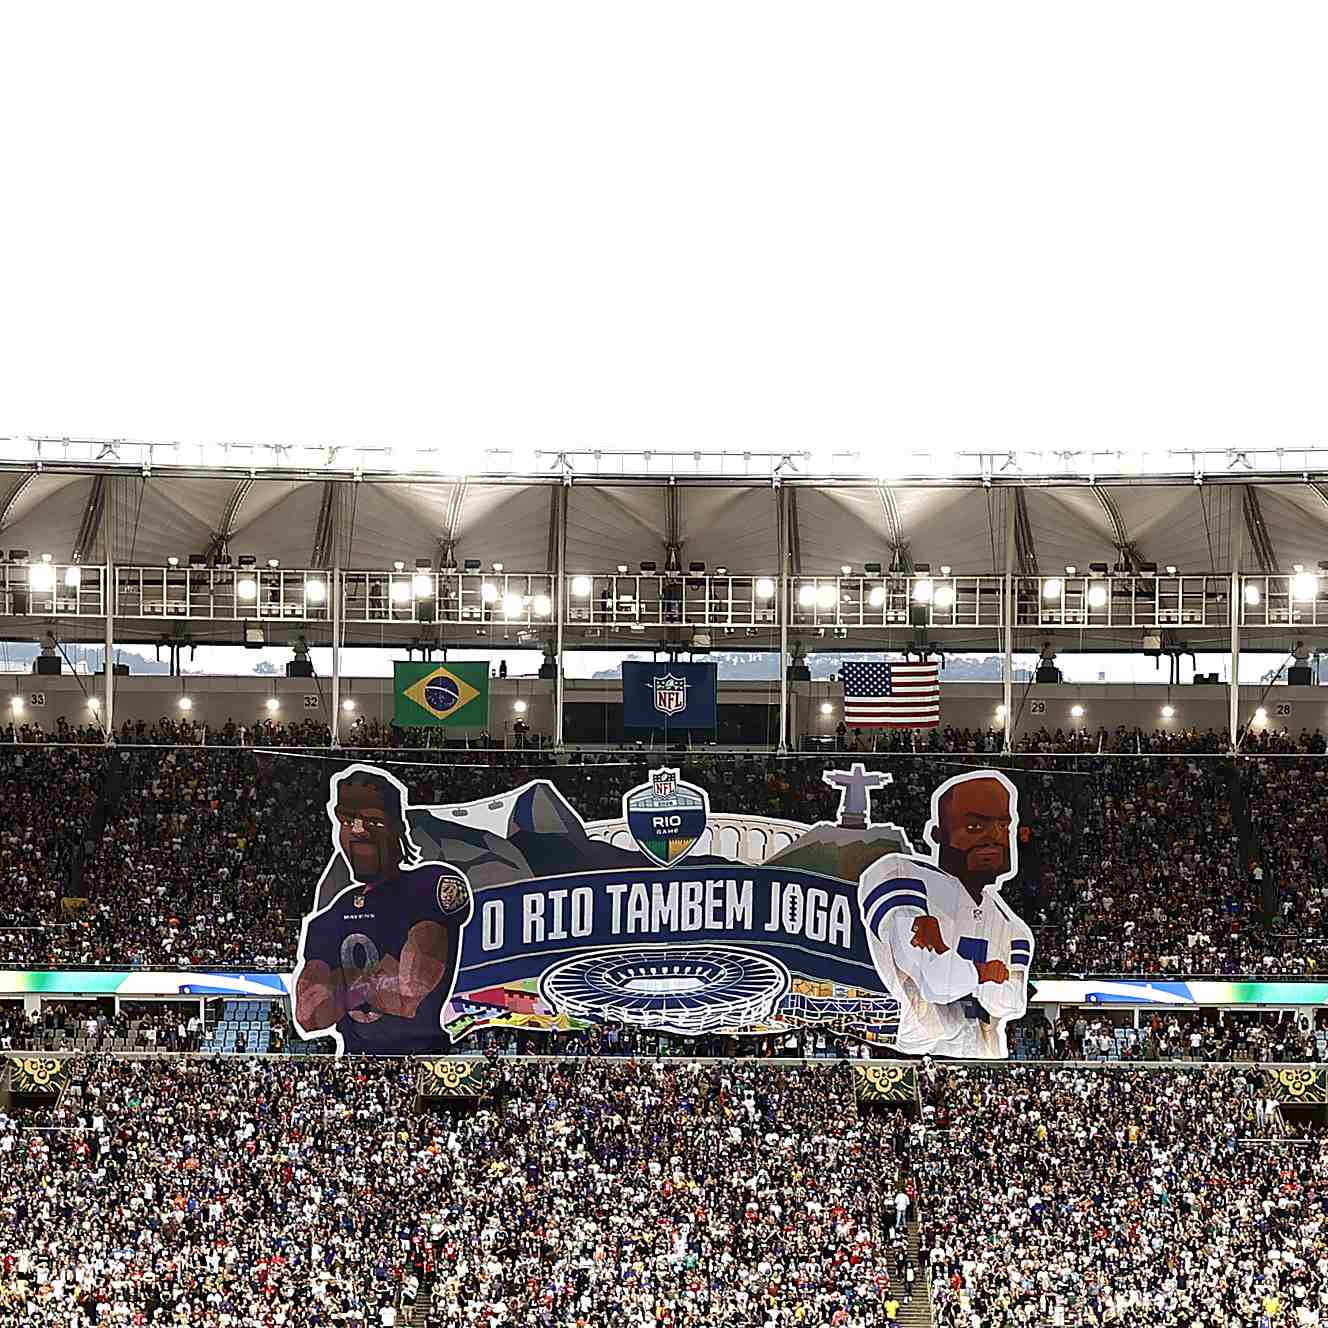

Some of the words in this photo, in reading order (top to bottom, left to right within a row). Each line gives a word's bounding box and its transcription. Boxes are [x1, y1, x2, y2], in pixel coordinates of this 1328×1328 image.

[304, 696, 318, 707] 32
[657, 691, 682, 708] NFL
[1032, 702, 1045, 713] 29
[1277, 704, 1290, 715] 28
[654, 782, 674, 796] NFL
[652, 815, 681, 827] RIO
[481, 899, 505, 951] O
[522, 887, 594, 944] RIO
[764, 880, 852, 949] JOGA
